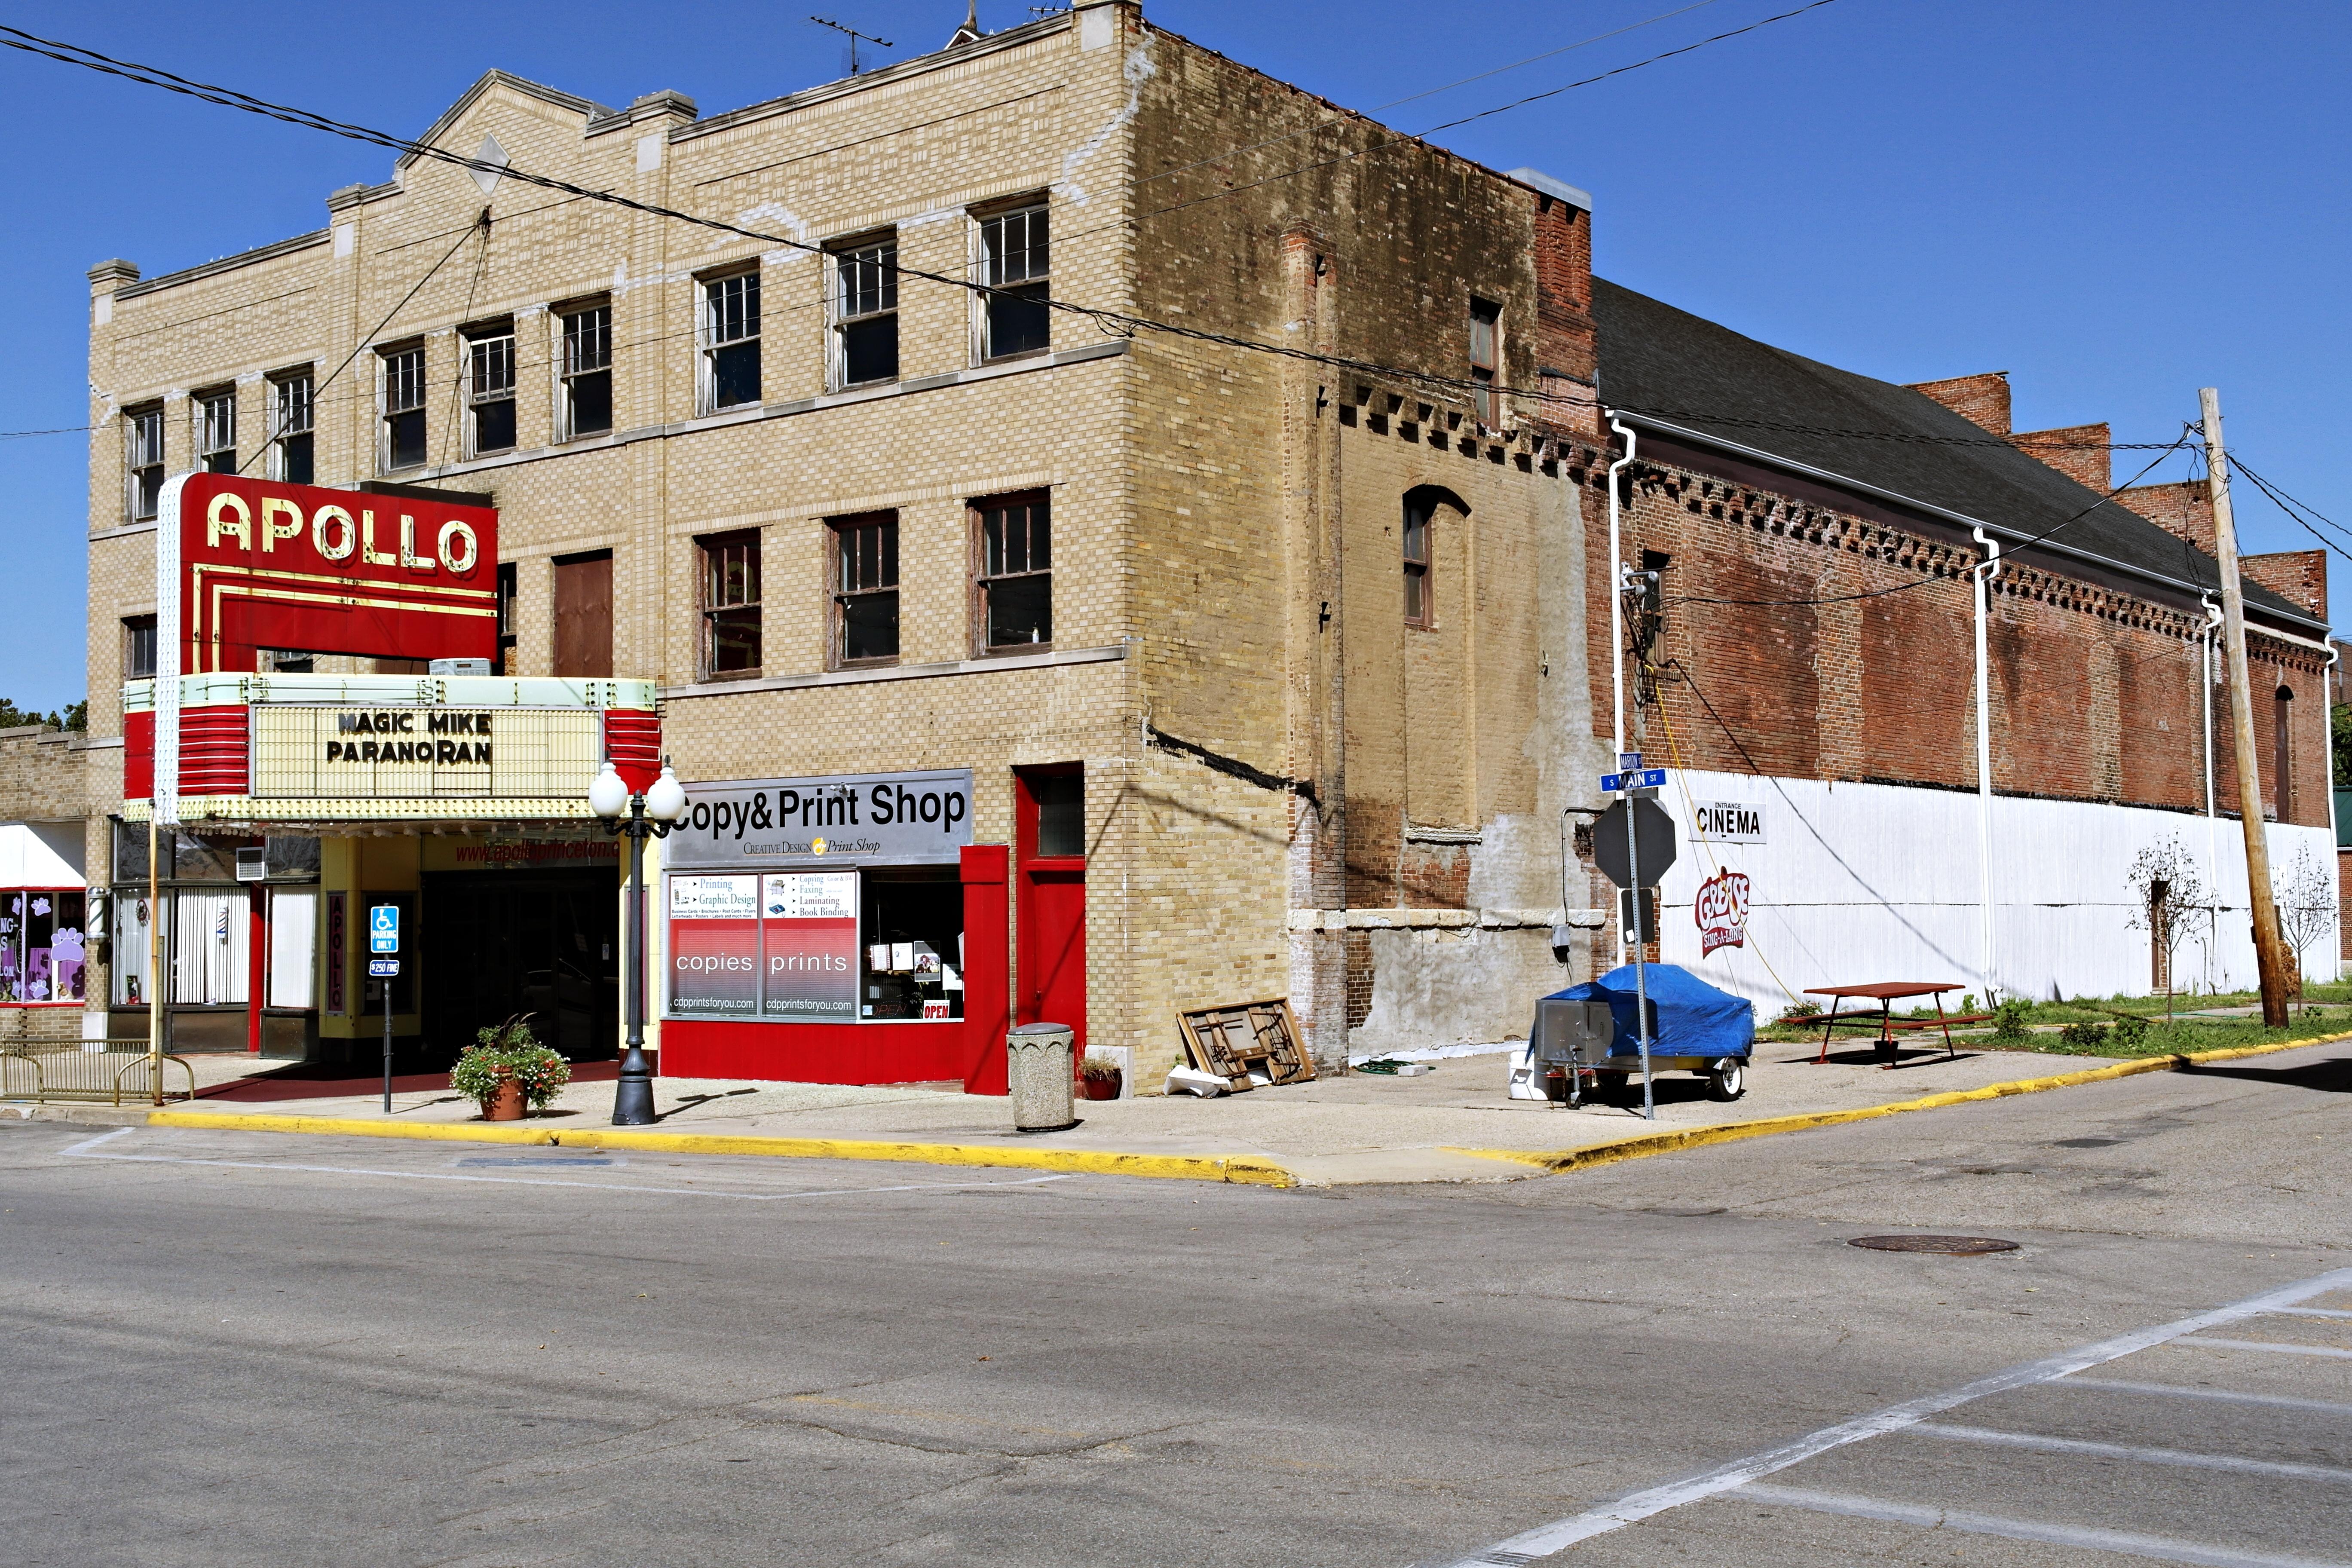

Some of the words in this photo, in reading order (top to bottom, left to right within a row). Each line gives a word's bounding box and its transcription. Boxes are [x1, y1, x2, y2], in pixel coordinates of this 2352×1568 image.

[207, 492, 478, 573] APOLLO
[338, 712, 413, 732] MAGIC
[428, 712, 490, 733] MIKE
[327, 739, 490, 763] PARANORAN
[1621, 755, 1638, 769] MARION
[1618, 773, 1645, 788] MAIN
[779, 788, 859, 827] Print
[871, 784, 965, 833] Shop
[1697, 807, 1760, 835] CINEMA
[744, 842, 781, 854] CREATIVE
[782, 841, 812, 853] DESIGN
[827, 840, 854, 852] Print
[855, 838, 880, 855] Shop
[700, 878, 733, 892] Printing
[799, 874, 824, 885] Copying
[799, 884, 823, 896] Faxing
[699, 894, 728, 908] Graphic
[731, 893, 756, 907] Design
[800, 895, 840, 908] Laminating
[800, 907, 818, 916] Book
[821, 906, 849, 919] Binding
[0, 917, 18, 933] NG-
[372, 930, 397, 939] PARKING
[1704, 927, 1743, 948] SING-A-LONG
[332, 897, 342, 1007] APOLLO
[377, 940, 392, 949] ONLY
[386, 963, 398, 972] FINE
[677, 952, 753, 974] copies
[772, 952, 847, 975] prints
[674, 997, 753, 1010] cdpprintsforyou.com
[766, 998, 851, 1012] cdpprintsforyou.com
[924, 1005, 949, 1019] OPEN
